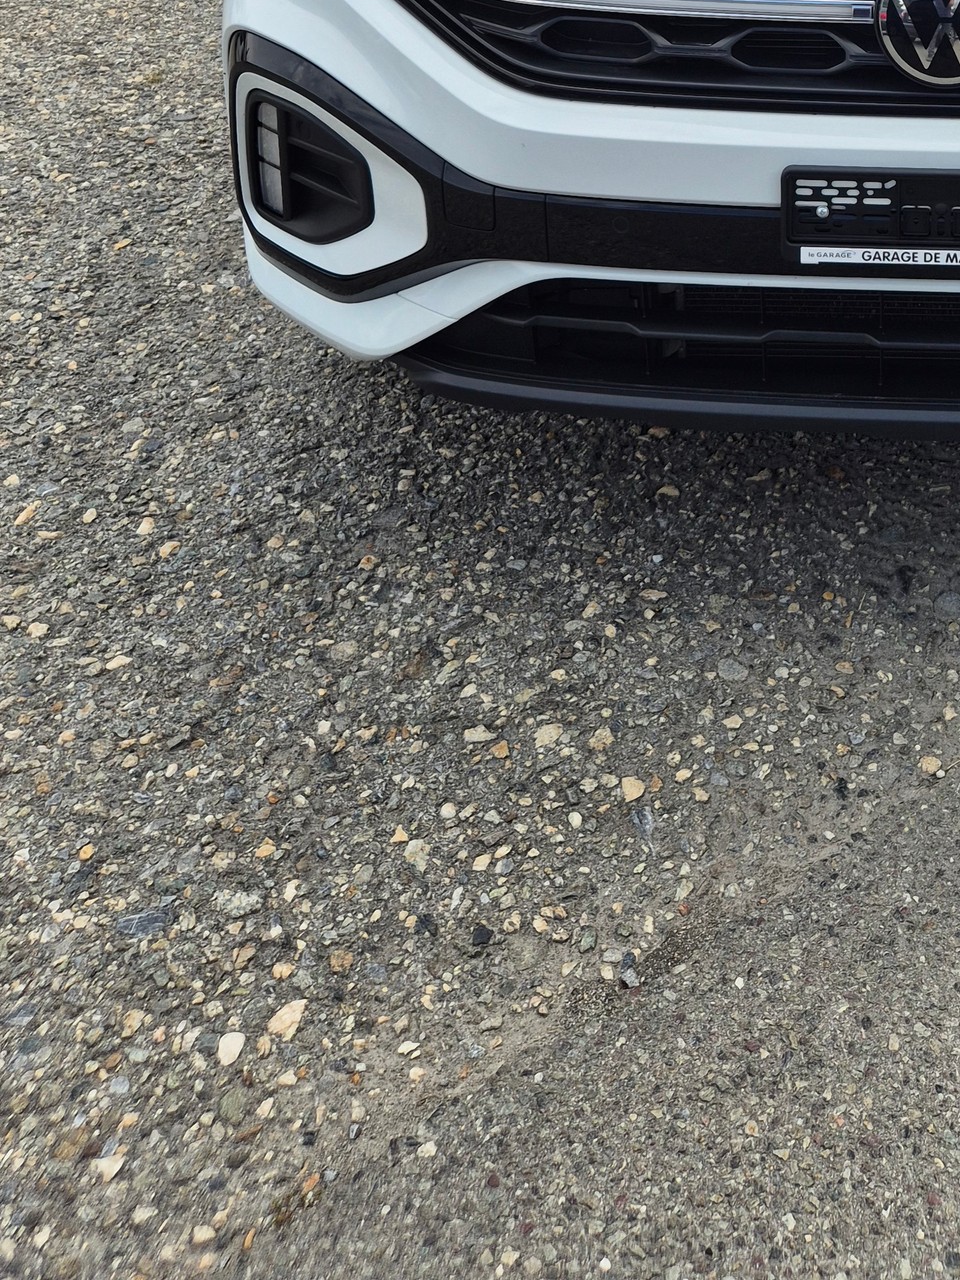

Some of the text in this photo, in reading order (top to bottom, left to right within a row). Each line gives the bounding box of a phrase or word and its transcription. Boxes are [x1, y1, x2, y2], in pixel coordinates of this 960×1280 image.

[816, 251, 852, 259] GARAGE
[861, 250, 919, 263] GARAGE
[923, 252, 941, 263] DE
